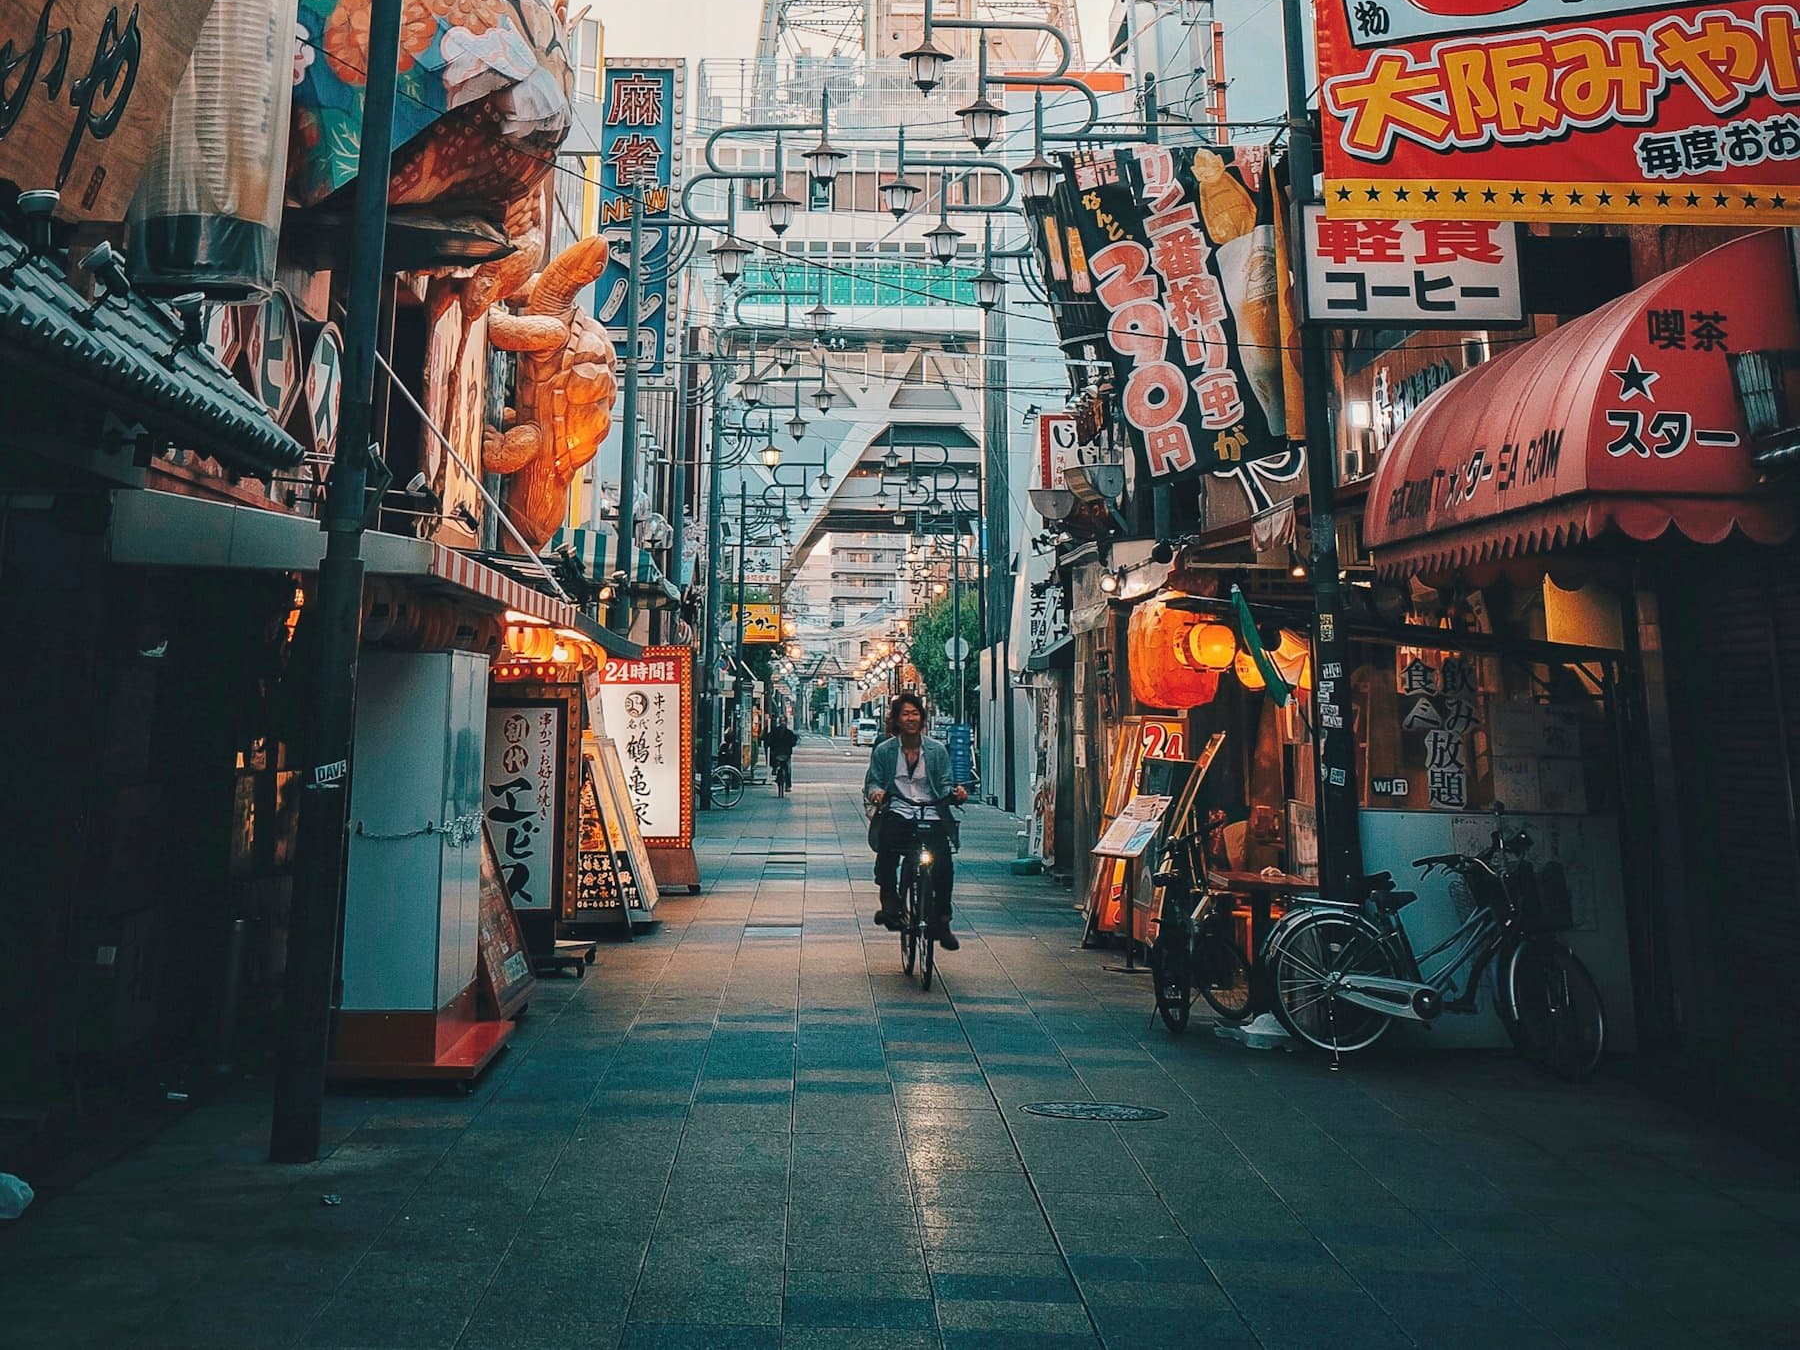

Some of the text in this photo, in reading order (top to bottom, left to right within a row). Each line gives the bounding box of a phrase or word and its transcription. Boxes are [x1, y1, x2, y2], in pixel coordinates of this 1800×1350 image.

[605, 72, 664, 187] 麻雀
[1316, 219, 1505, 265] 軽食
[1325, 270, 1501, 312] コーヒー
[1647, 310, 1728, 352] 喫茶
[1605, 409, 1741, 460] スター
[1401, 658, 1441, 730] 食べ
[1143, 724, 1185, 760] 24
[1425, 731, 1466, 808] 放題
